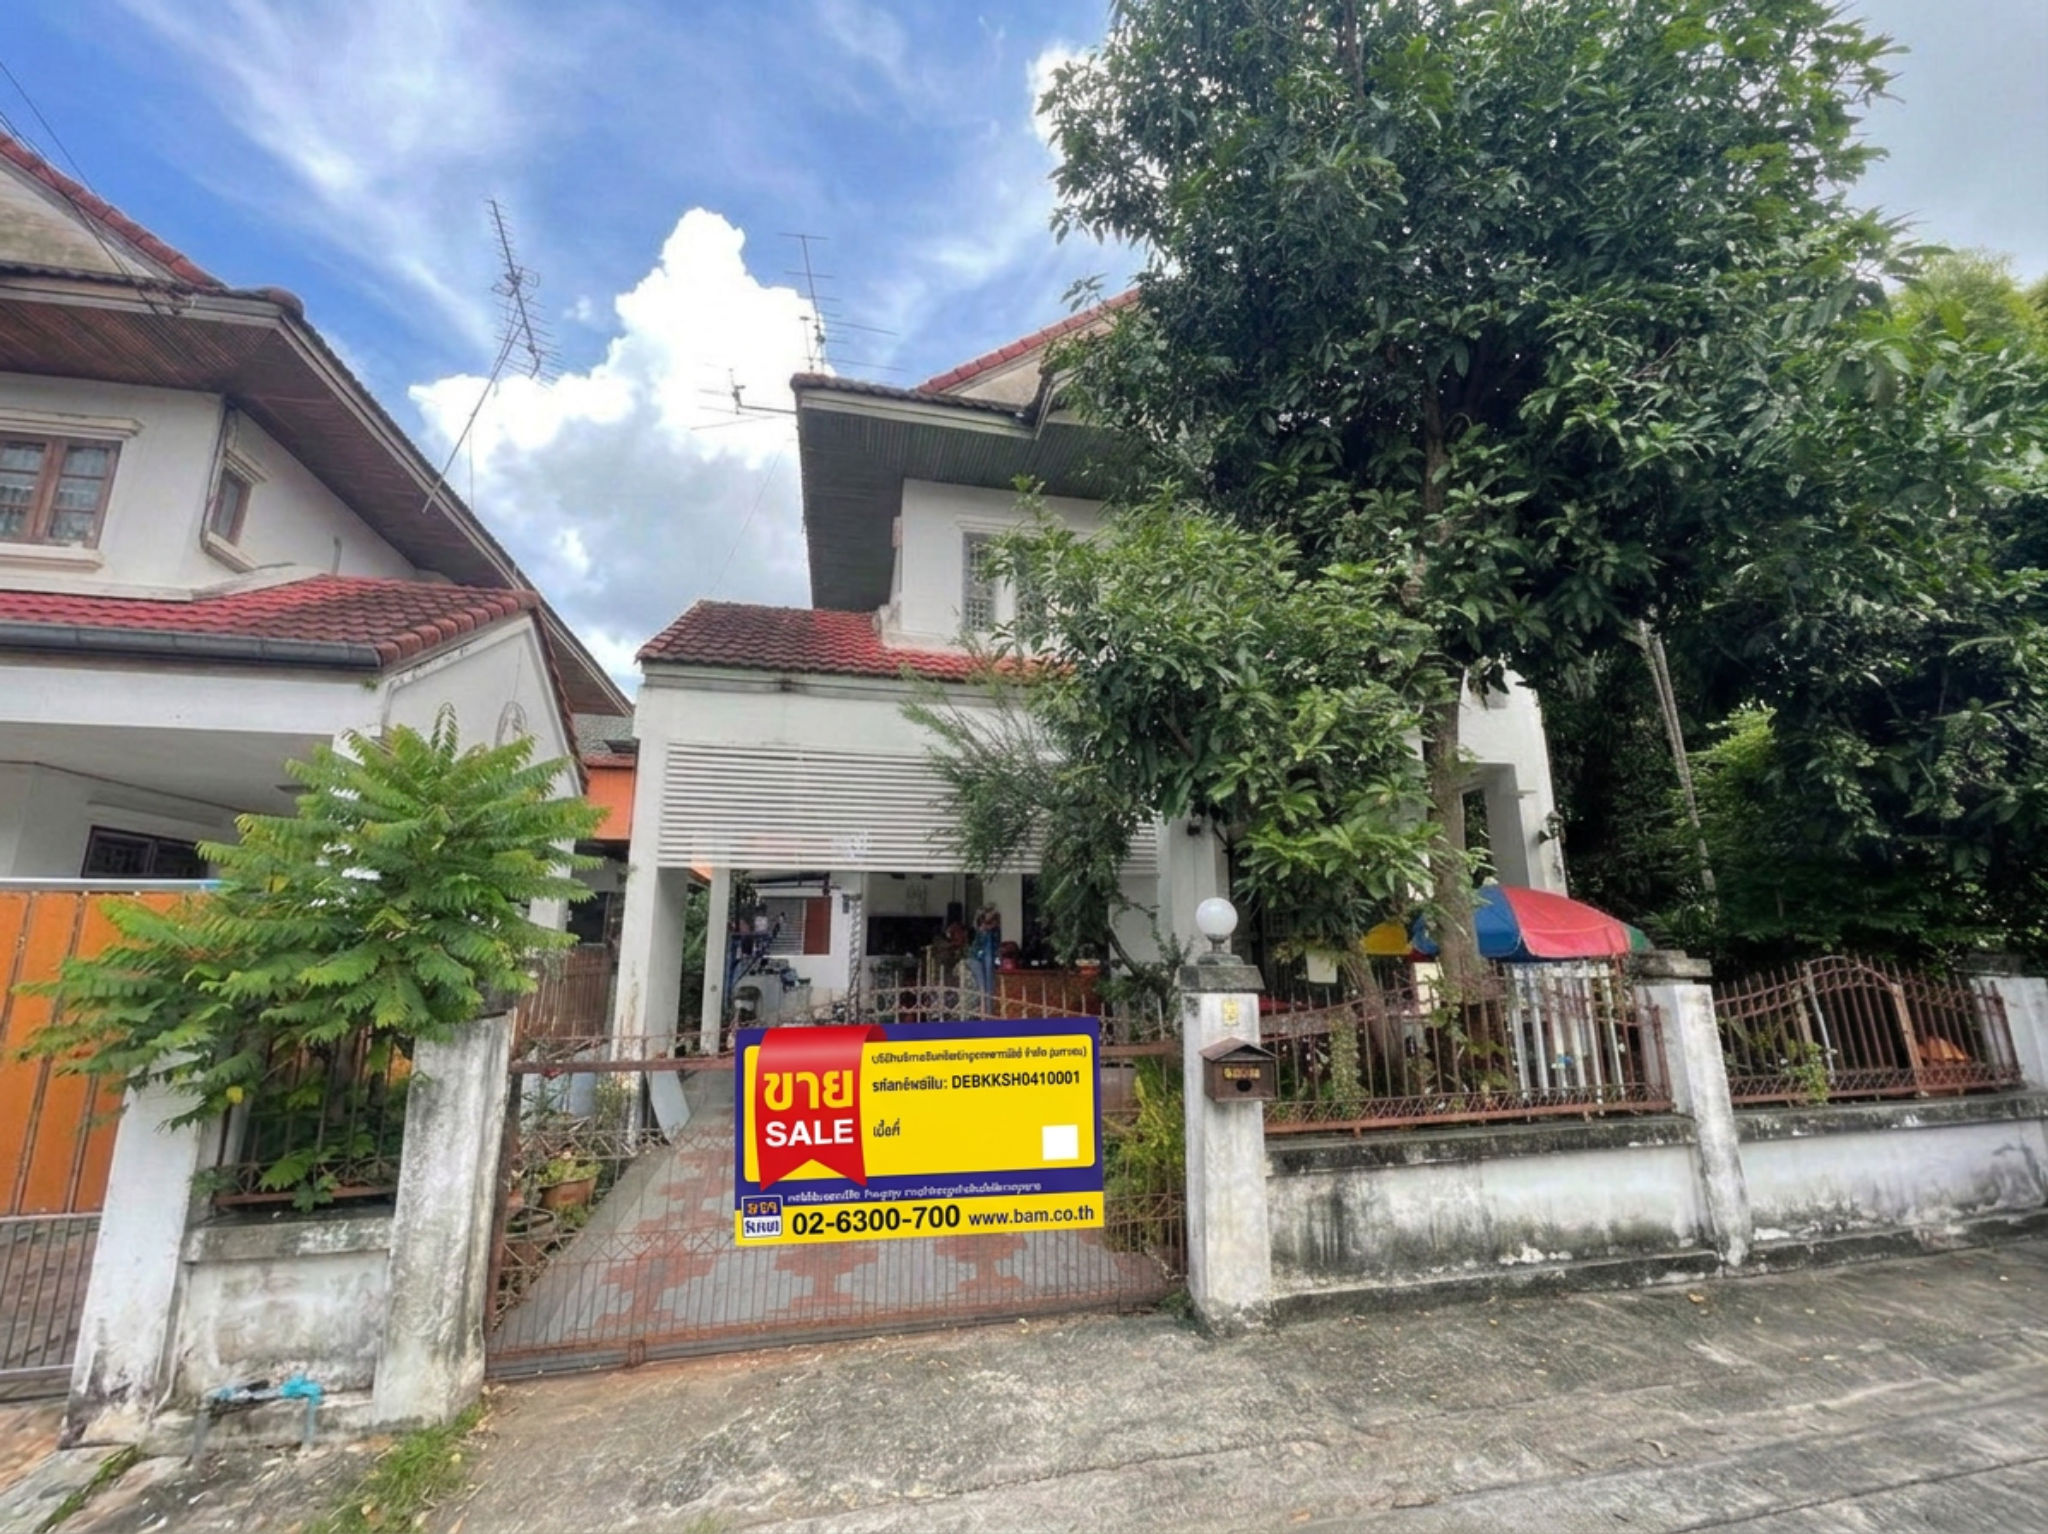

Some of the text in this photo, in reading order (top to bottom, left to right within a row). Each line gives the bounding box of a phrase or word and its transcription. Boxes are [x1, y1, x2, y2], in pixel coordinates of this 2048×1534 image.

[763, 1069, 854, 1111] ขาย
[952, 1070, 1080, 1089] DEBKKSH0410001
[765, 1118, 854, 1148] SALE
[792, 1205, 960, 1236] 02-6300-700
[968, 1205, 1095, 1227] www.bam.co.th
